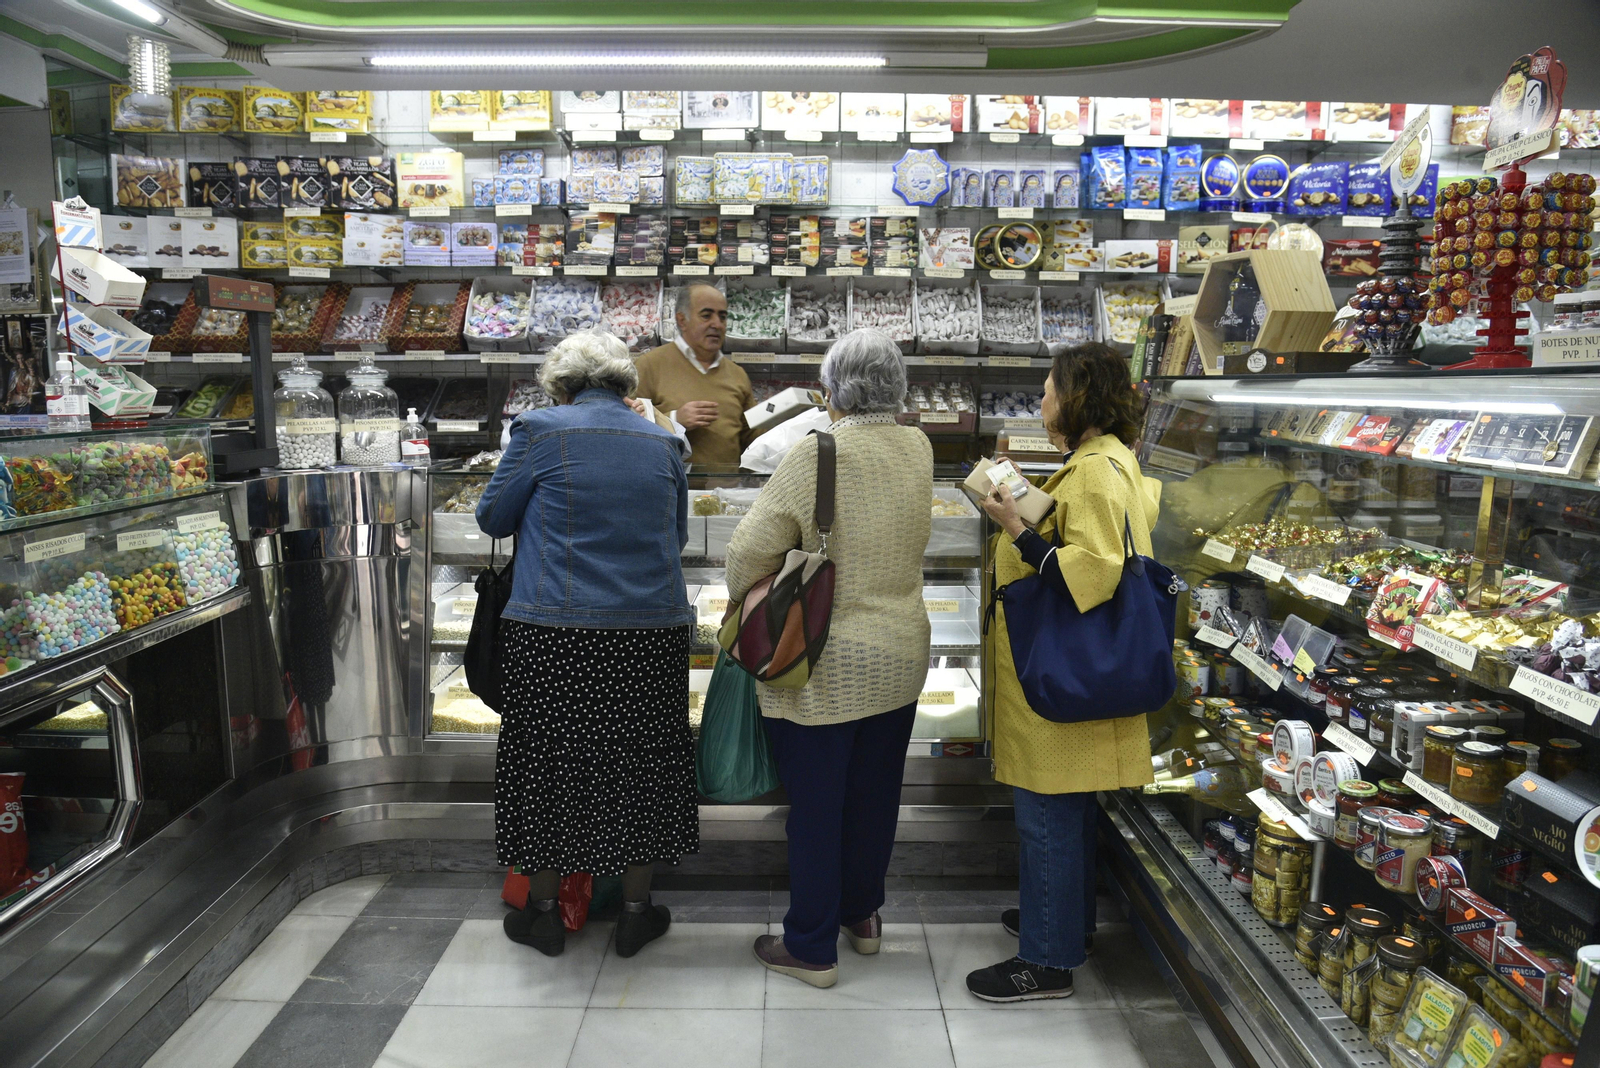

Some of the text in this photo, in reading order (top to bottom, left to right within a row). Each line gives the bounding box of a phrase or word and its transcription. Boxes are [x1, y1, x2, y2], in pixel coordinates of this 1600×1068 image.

[1303, 180, 1331, 190] Victoria
[1159, 250, 1169, 263] 5
[1541, 338, 1568, 347] BOTES
[1570, 337, 1583, 346] DE
[287, 419, 319, 427] PELADILLAS
[25, 542, 45, 554] ANISES
[66, 534, 85, 545] COLOR
[1416, 626, 1473, 659] MARRON GLACE EXTRA
[1517, 669, 1600, 709] HIGOS CON CHOCOLATE
[1531, 687, 1570, 709] PVP. 46.50 E
[1405, 775, 1451, 809] MIEL CON PIÑONES
[1460, 806, 1497, 836] ALMENDRAS
[1532, 828, 1566, 853] NEGRO
[1549, 824, 1568, 841] AJO
[1452, 921, 1487, 933] CONSORCIO
[1570, 924, 1588, 941] AJO
[1010, 969, 1039, 993] N
[1424, 992, 1453, 1016] SALADITOS
[1469, 1028, 1494, 1054] SALADITOS
